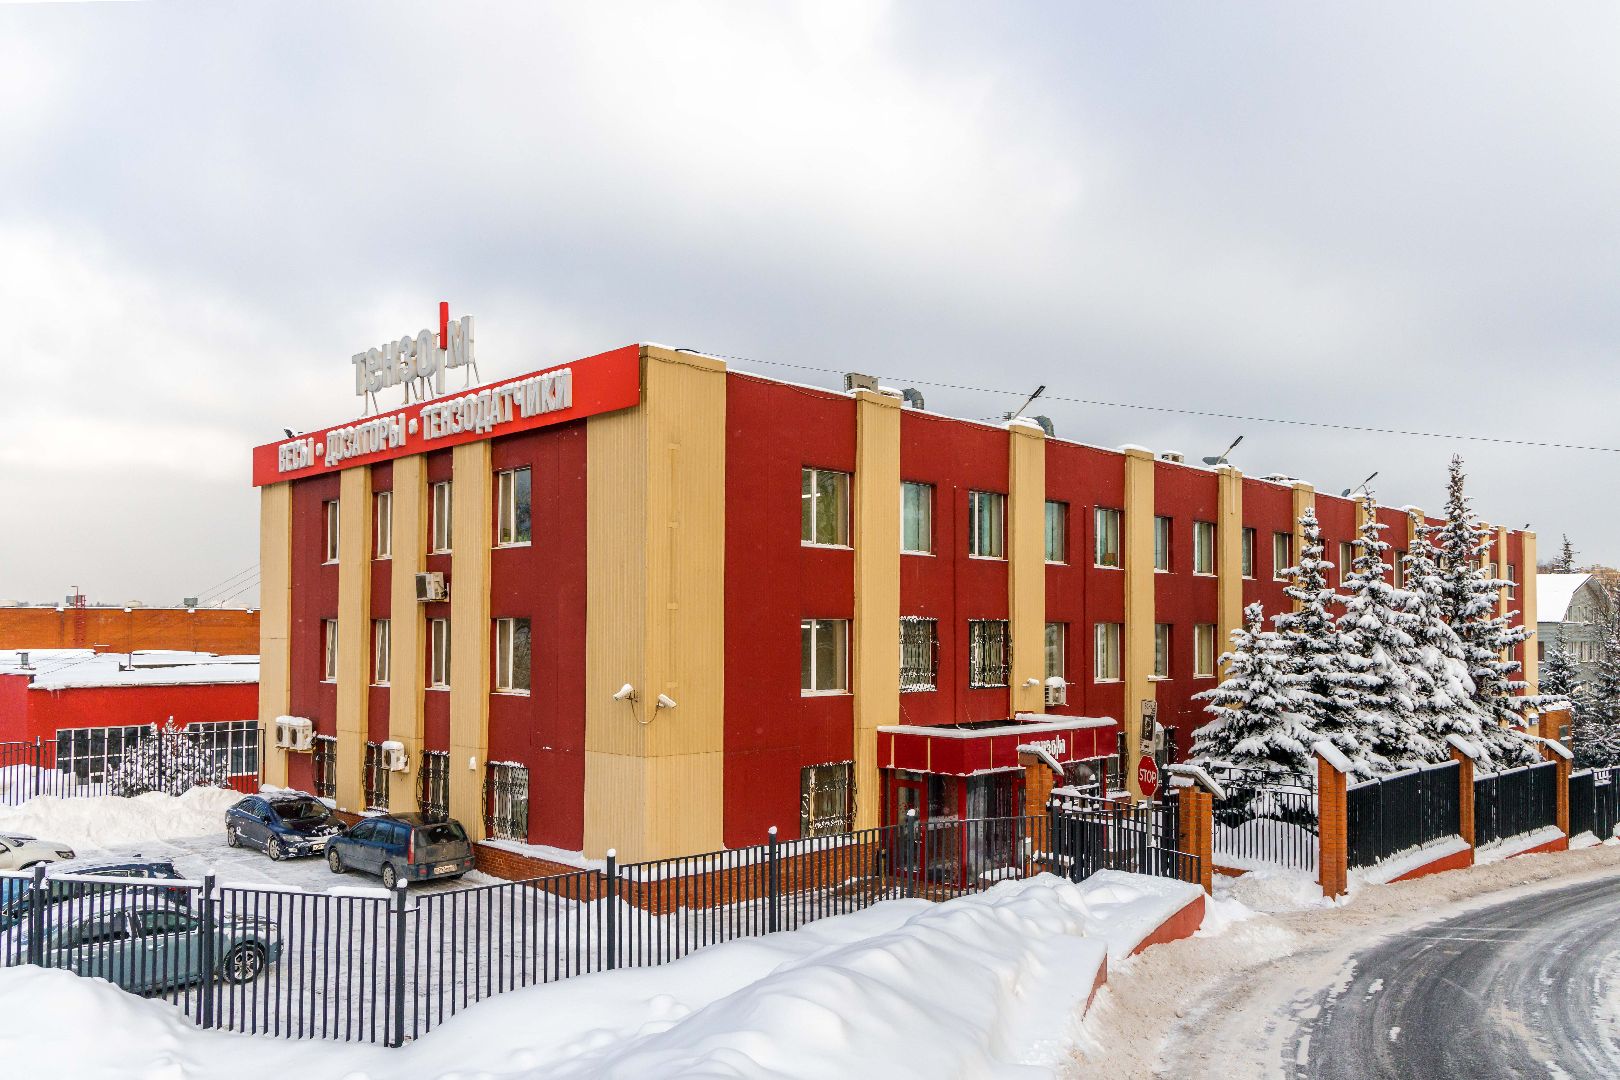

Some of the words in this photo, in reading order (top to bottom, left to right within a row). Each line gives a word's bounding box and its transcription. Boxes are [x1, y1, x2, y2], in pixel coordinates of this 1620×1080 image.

[279, 437, 314, 472] ВЕСЫ
[325, 413, 406, 467] ДОЗАТОРЫ
[420, 368, 572, 440] ТЕНЗОДАТЧИКИ
[1139, 768, 1157, 783] STOP
